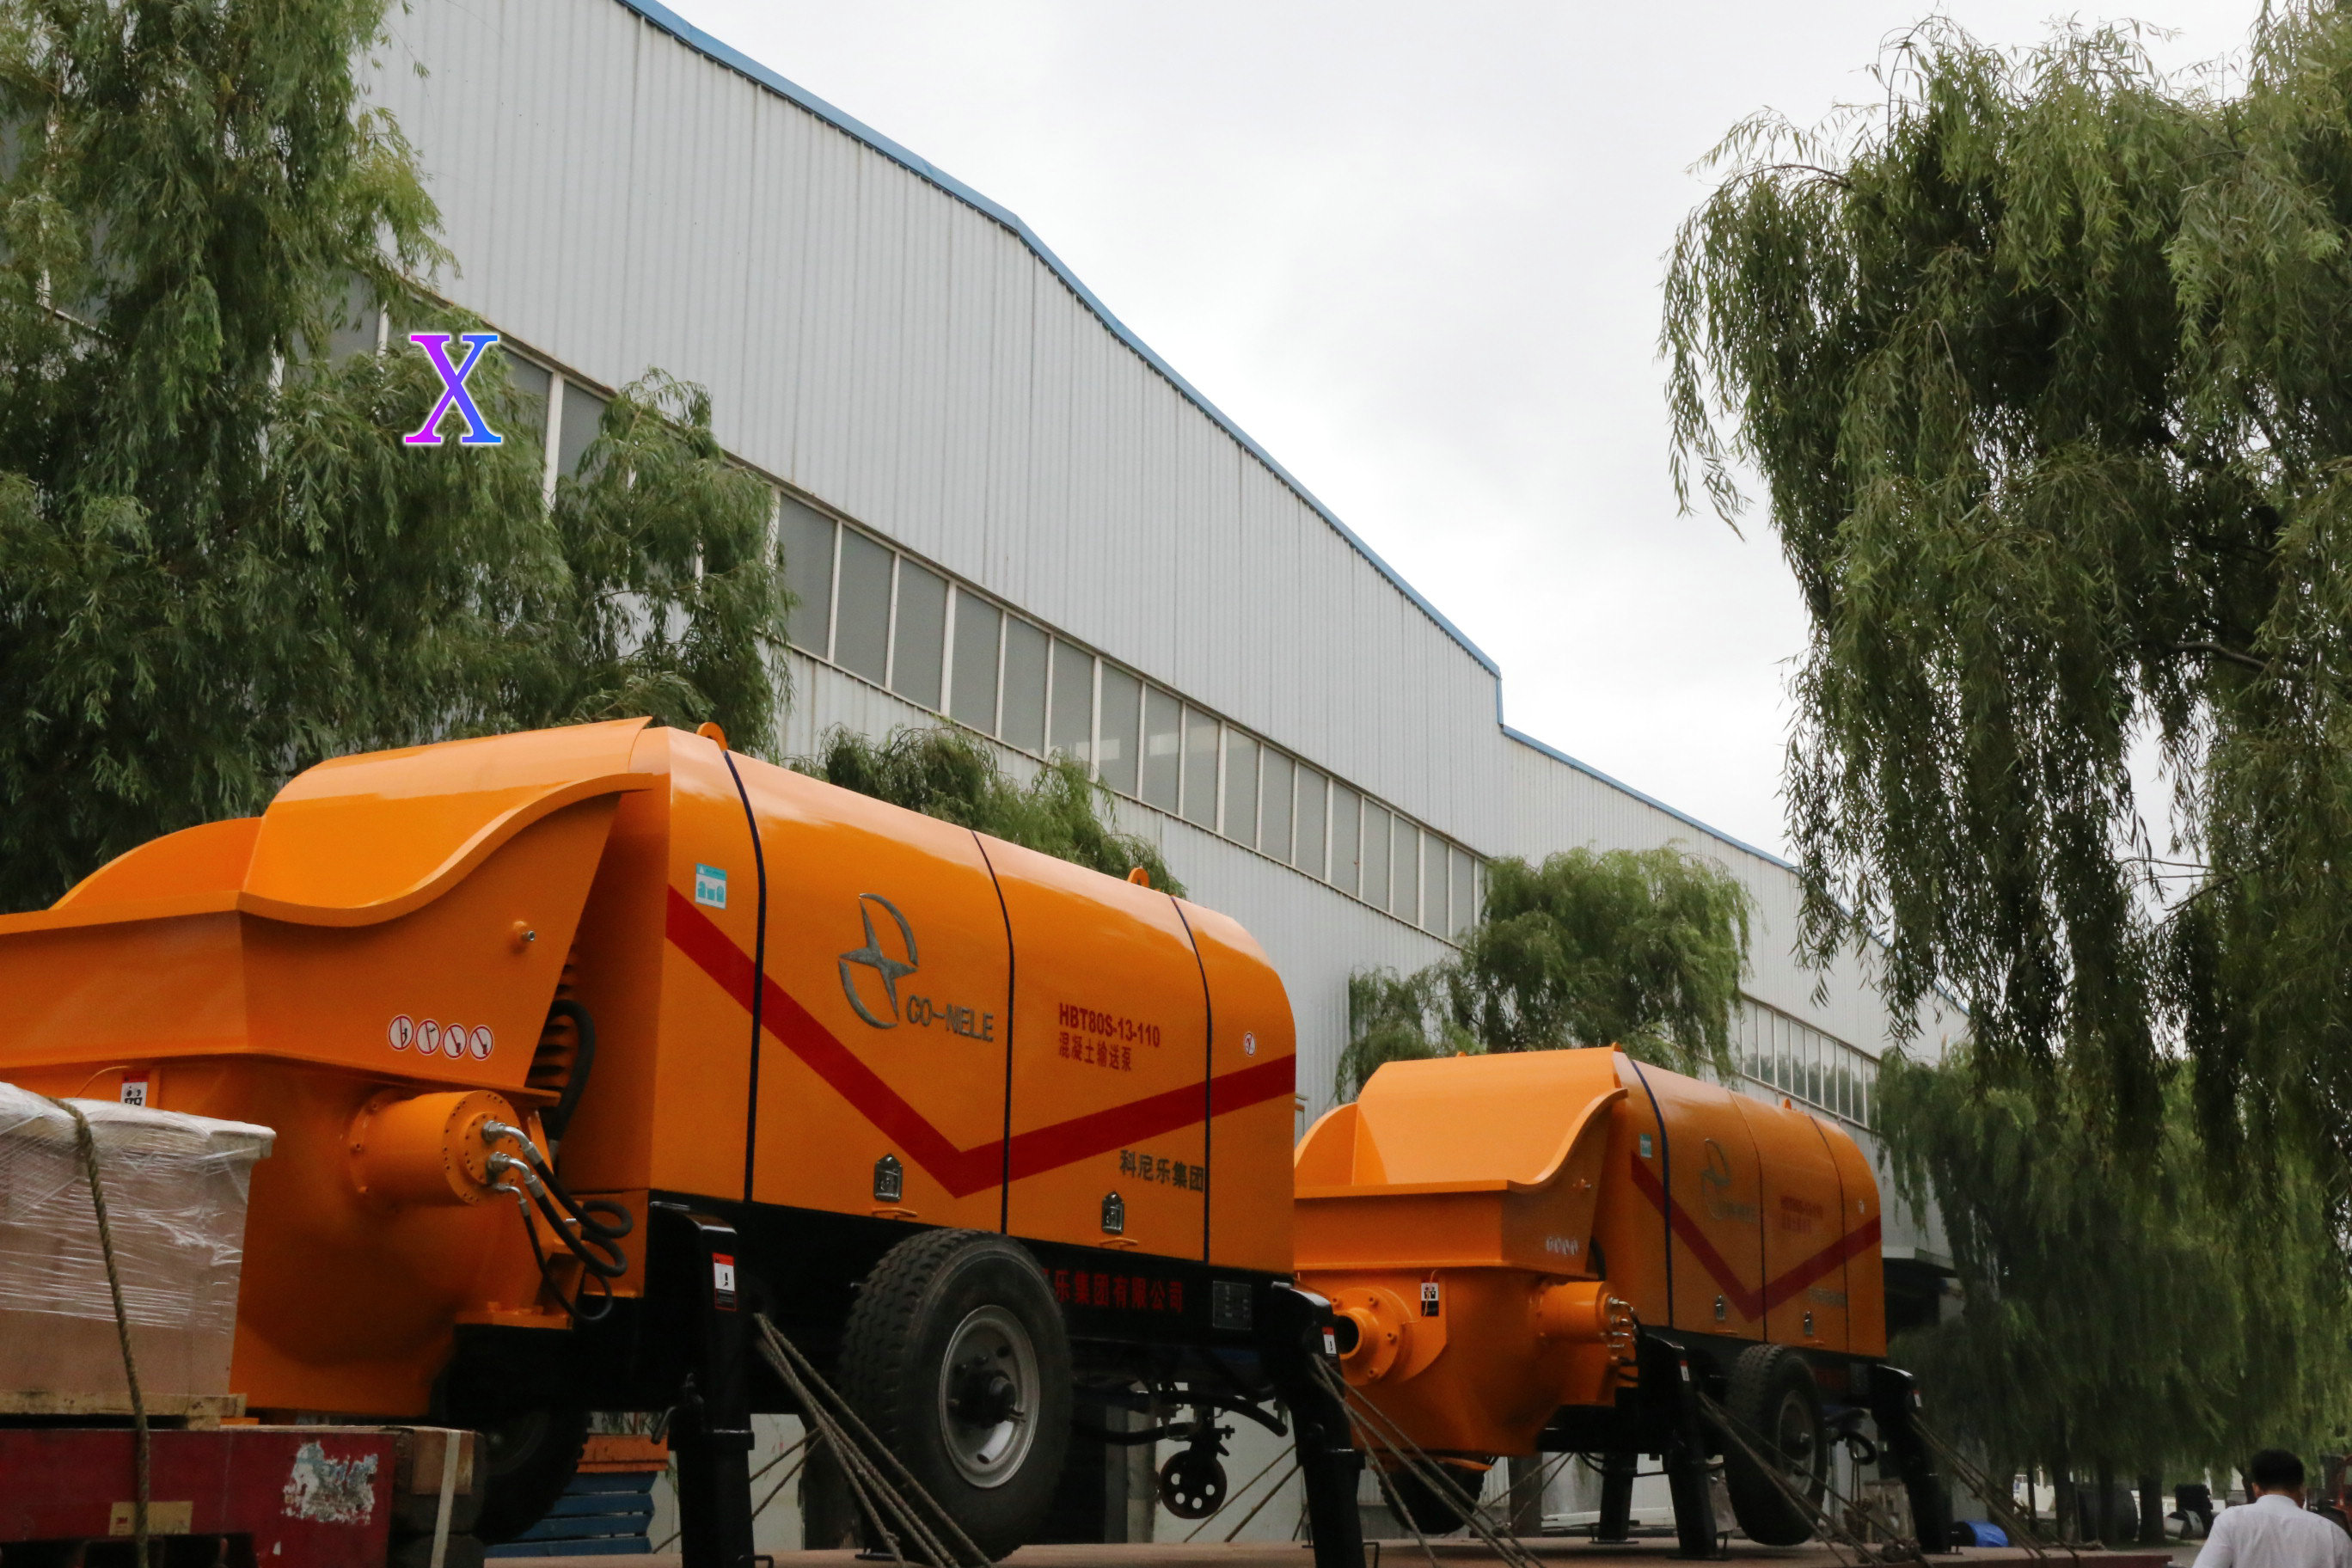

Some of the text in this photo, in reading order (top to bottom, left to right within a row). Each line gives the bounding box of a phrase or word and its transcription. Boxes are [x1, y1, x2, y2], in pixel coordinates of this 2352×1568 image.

[907, 994, 994, 1042] CO-NELE
[1059, 1002, 1161, 1048] HBT80S-13-110
[1059, 1032, 1132, 1071] 混凝土输送泵
[1119, 1149, 1204, 1193] 科尼乐集团
[1042, 1268, 1184, 1313] 乐集团有限公司
